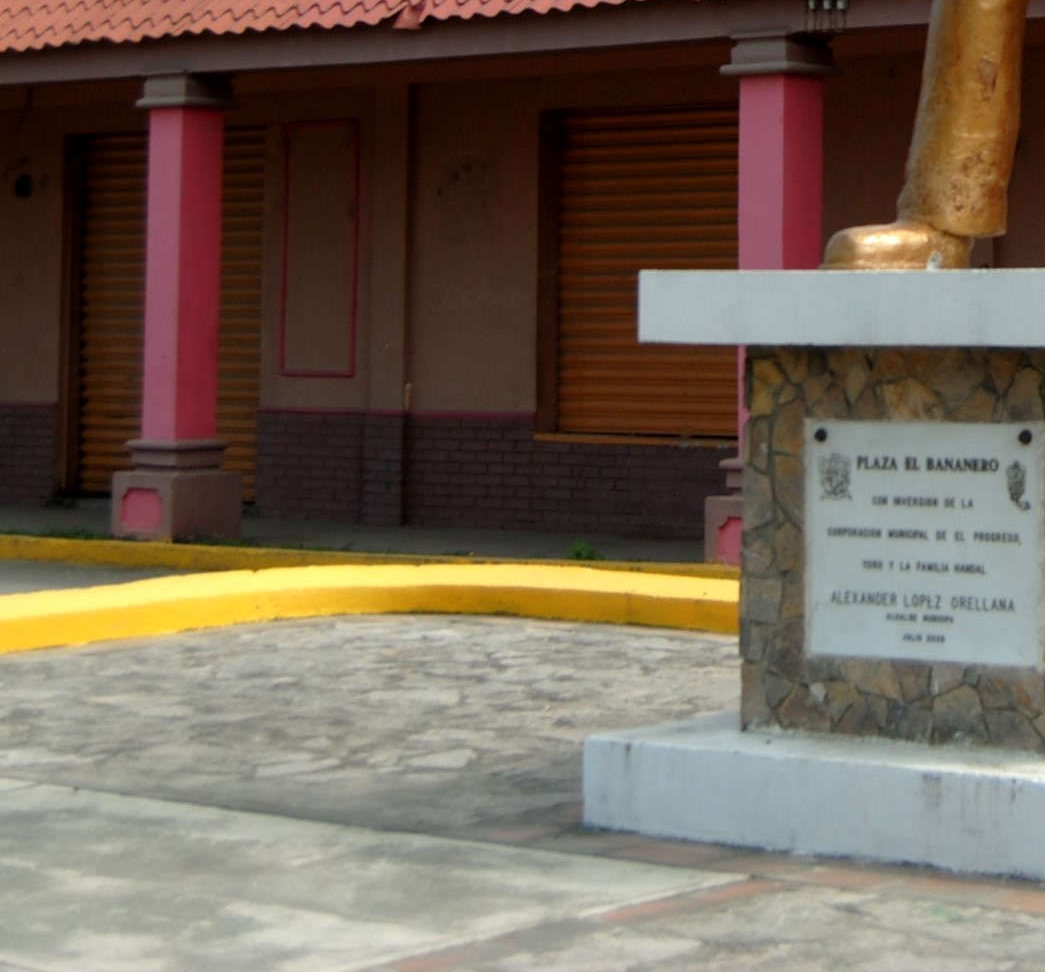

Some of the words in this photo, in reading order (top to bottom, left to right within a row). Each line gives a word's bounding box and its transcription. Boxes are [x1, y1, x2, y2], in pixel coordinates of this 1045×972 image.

[856, 456, 897, 471] PLAZA
[905, 457, 920, 471] EL
[926, 457, 999, 472] BANANERO
[872, 496, 888, 505] CON
[894, 496, 938, 507] INVERSION
[945, 498, 954, 508] DE
[961, 499, 973, 508] LA
[827, 527, 881, 538] CORPORACION
[888, 529, 928, 540] MUNICIPAL
[936, 531, 946, 541] DE
[955, 531, 965, 541] EL
[862, 560, 883, 571] YORO
[889, 561, 894, 570] Y
[899, 561, 910, 571] LA
[916, 561, 949, 573] FAMILIA
[831, 590, 897, 607] ALEXANDER
[951, 595, 1015, 612] ORELLANA
